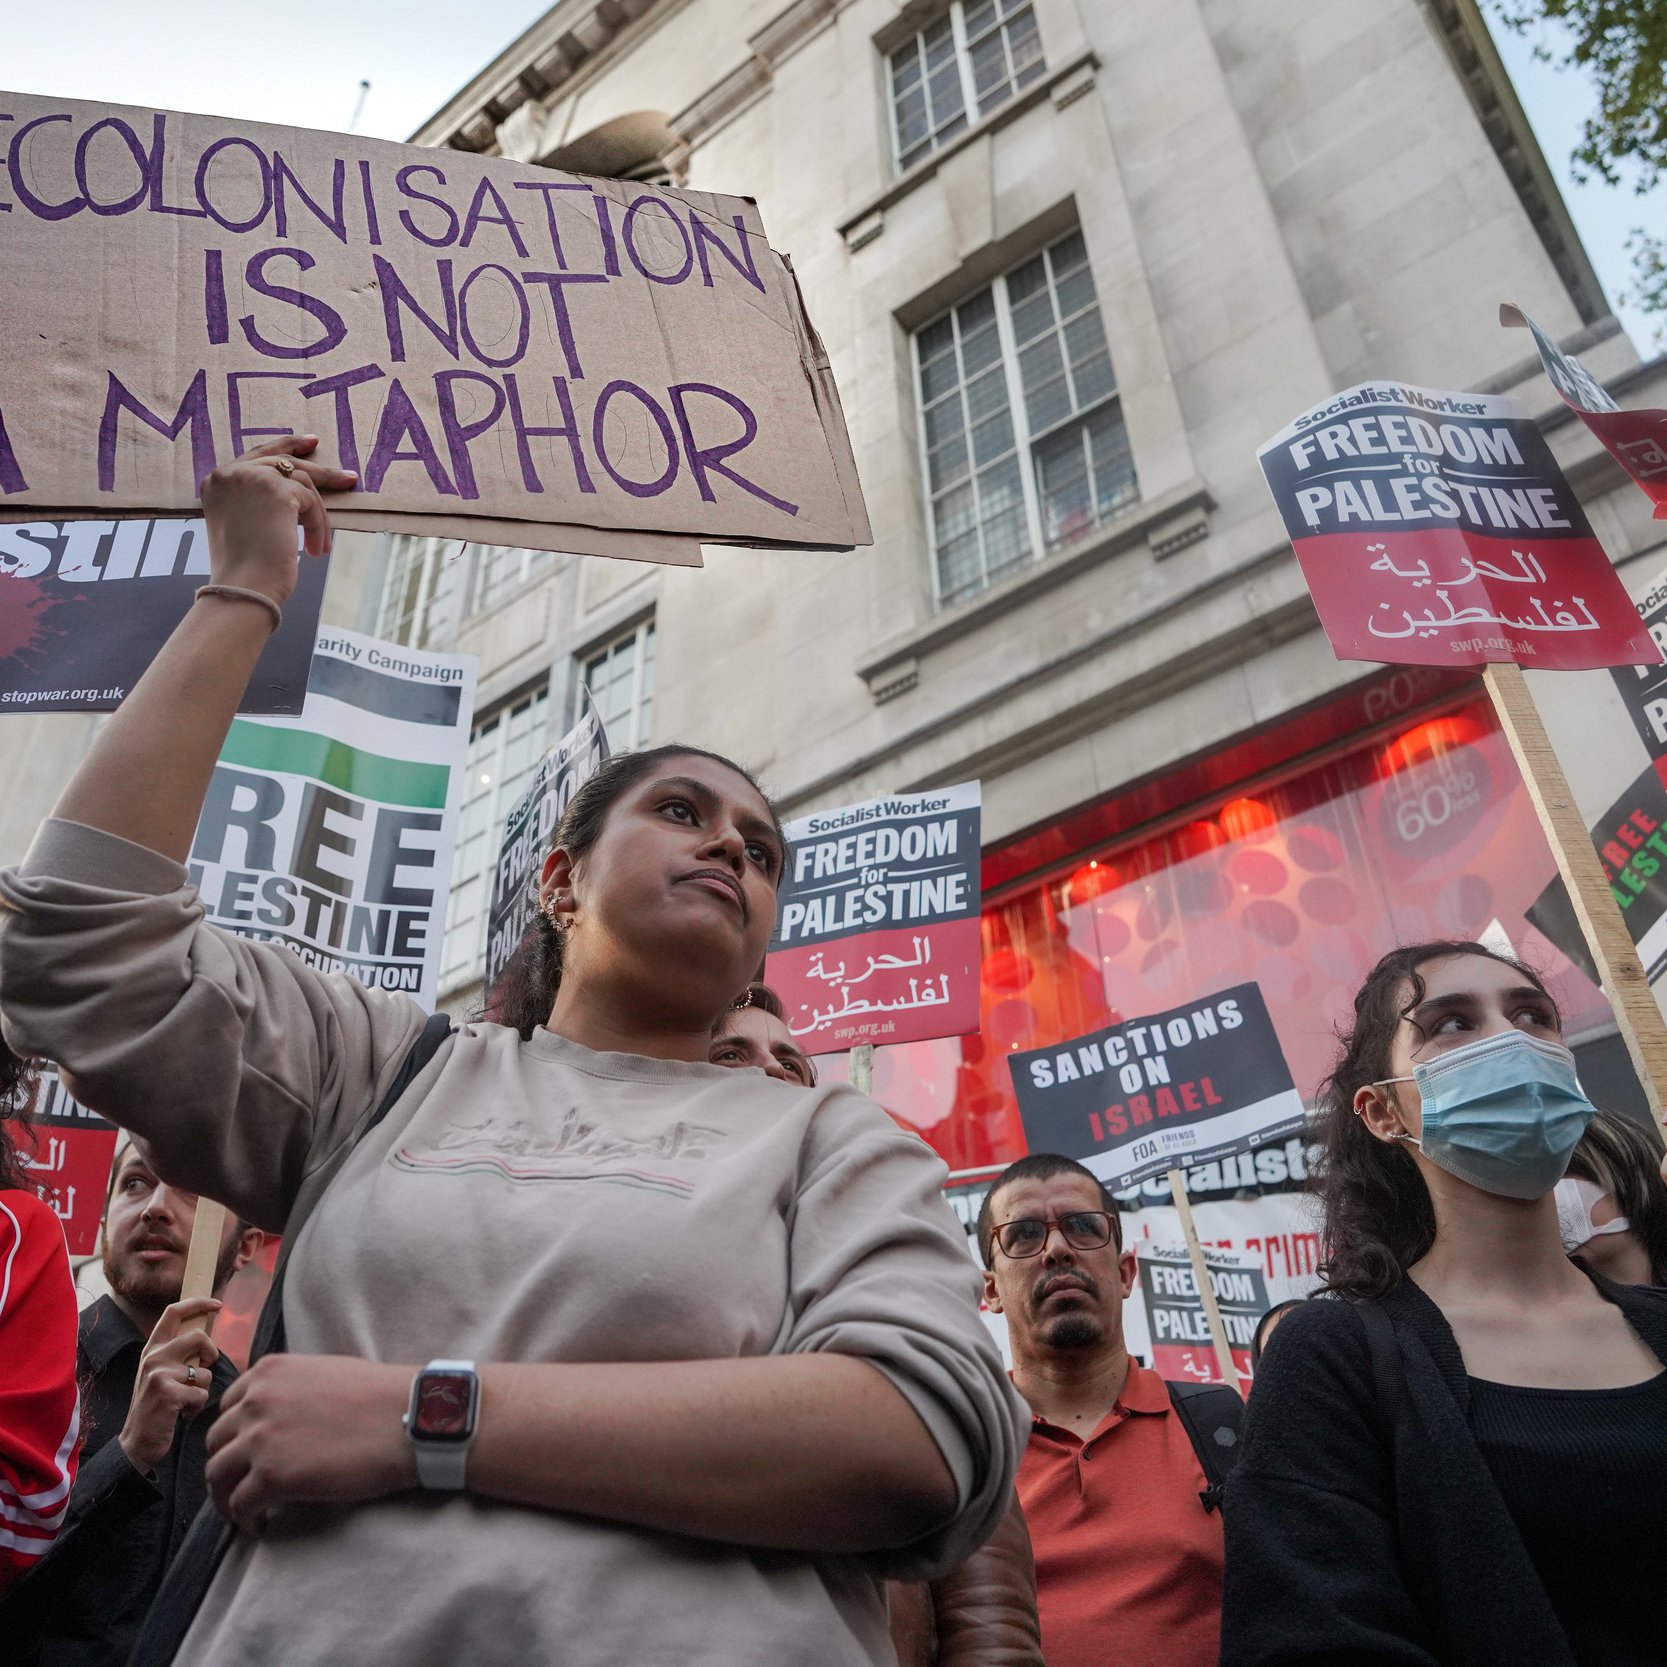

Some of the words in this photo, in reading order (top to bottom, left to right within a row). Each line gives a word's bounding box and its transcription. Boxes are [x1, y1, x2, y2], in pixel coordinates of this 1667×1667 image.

[204, 247, 348, 360] IS
[372, 253, 610, 380] NOT
[97, 363, 800, 517] METAPHOR
[1289, 414, 1525, 471] FREEDOM
[1402, 453, 1444, 475] for
[1294, 477, 1572, 529] PALESTINE
[1367, 589, 1600, 638] لفلسطين
[368, 649, 464, 682] Campaign
[1449, 636, 1537, 656] swp.org.uk
[2, 686, 125, 704] stopwar.org.uk
[794, 819, 958, 883] FREEDOM
[859, 866, 888, 886] for
[780, 872, 967, 942] PALESTINE
[805, 936, 931, 987] الحرية
[787, 973, 950, 1036] لفلسطين
[834, 1020, 896, 1039] swp.org.uk
[1029, 999, 1244, 1090] SANCTIONS
[1119, 1055, 1171, 1095] ON
[1088, 1076, 1223, 1142] ISRAEL
[1132, 1139, 1158, 1162] FOA
[1161, 1129, 1196, 1145] FRIENDS
